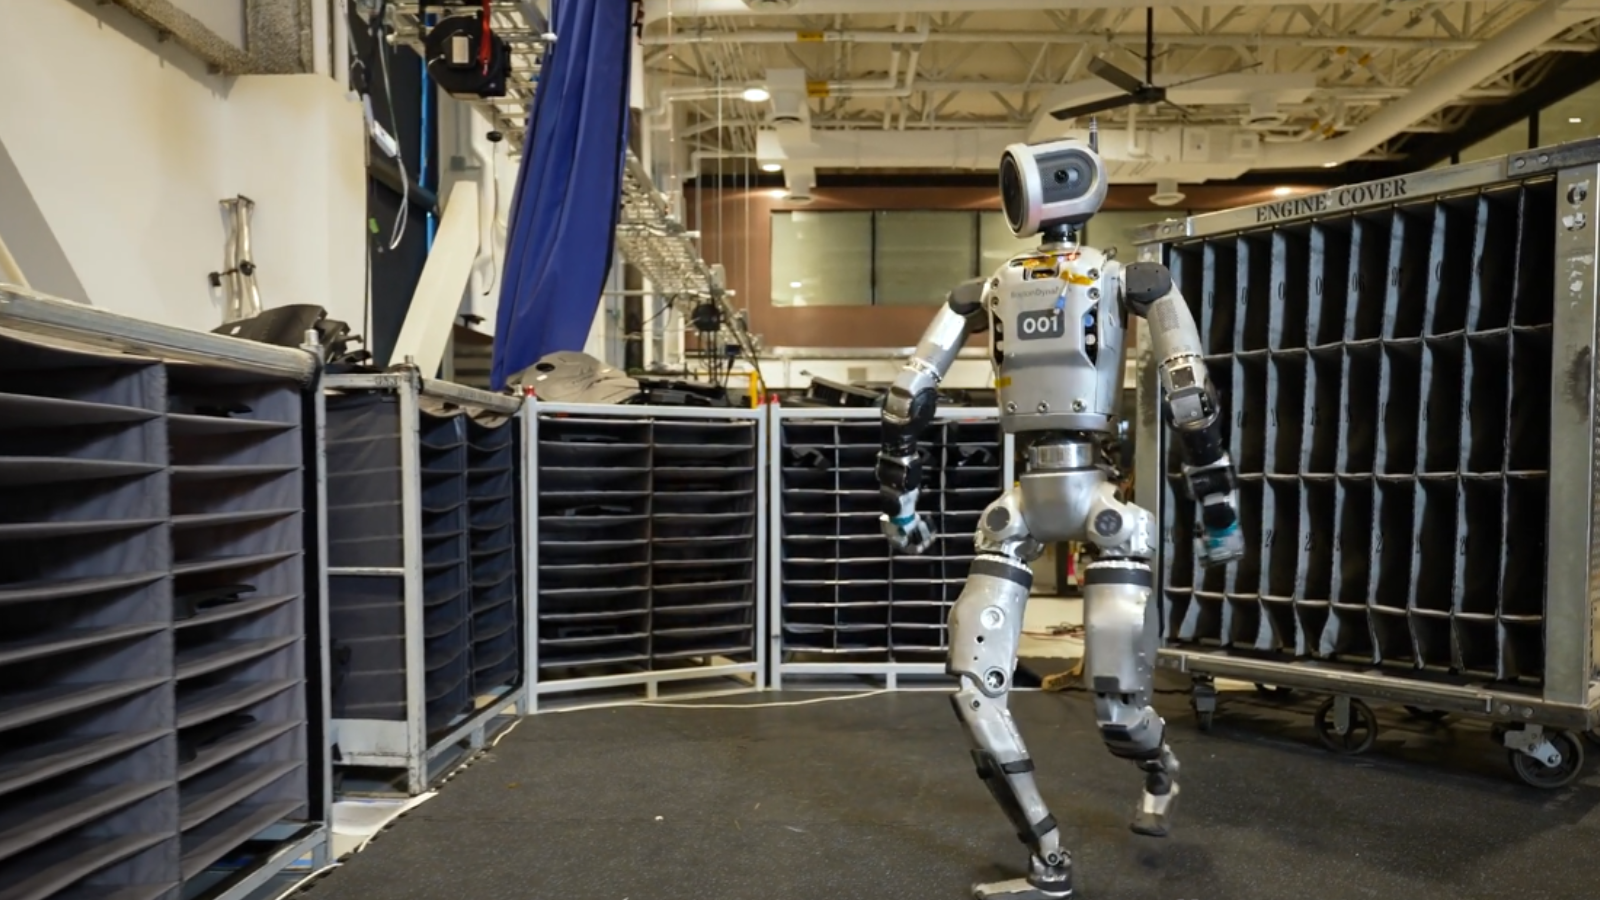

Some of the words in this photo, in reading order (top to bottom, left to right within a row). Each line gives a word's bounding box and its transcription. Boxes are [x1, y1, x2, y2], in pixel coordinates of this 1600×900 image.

[1256, 194, 1327, 222] ENGINE
[1338, 178, 1407, 206] COVER
[1023, 315, 1058, 334] 001
